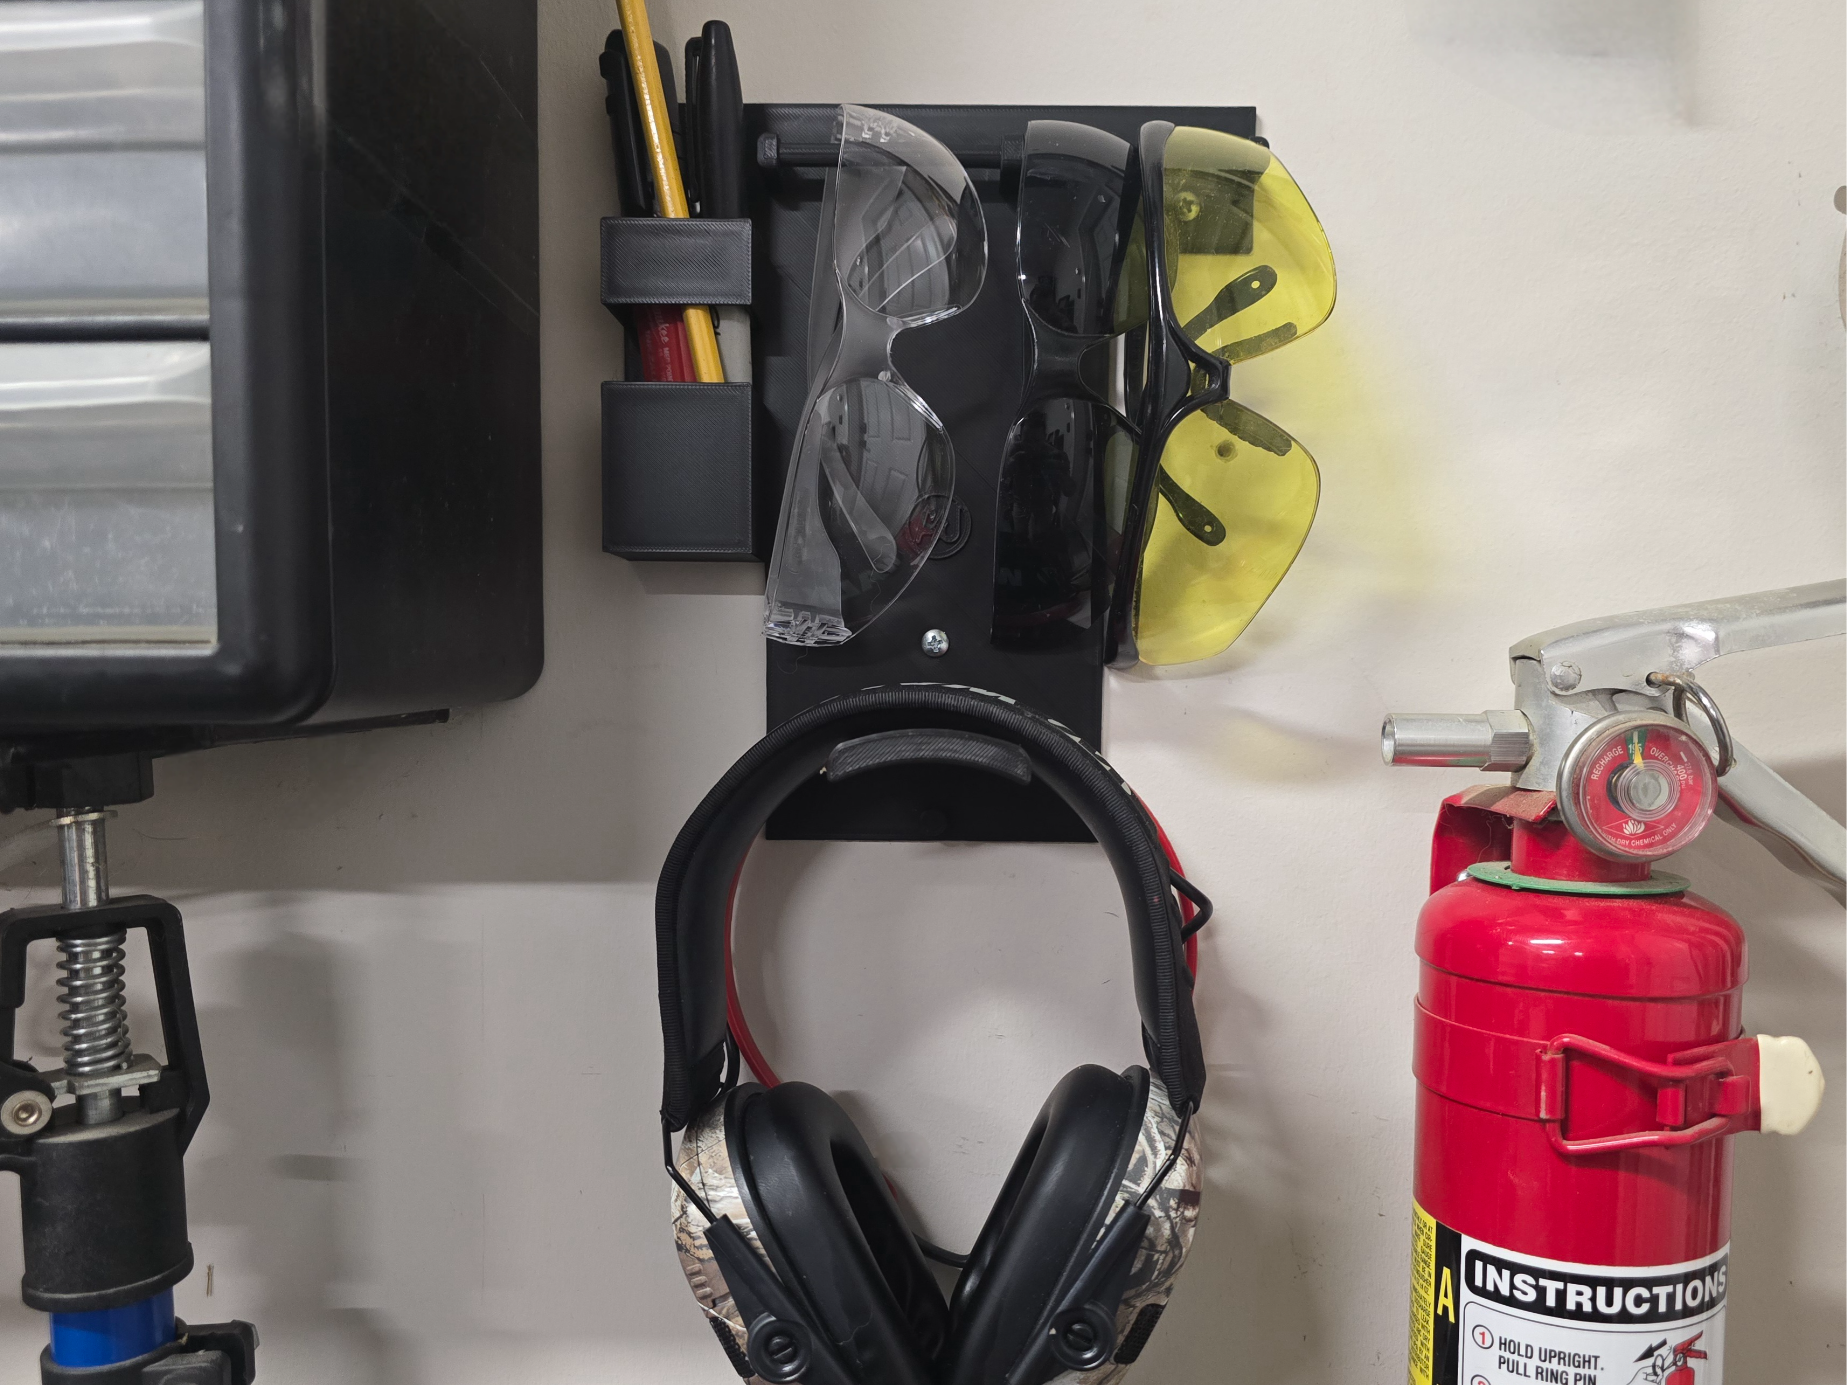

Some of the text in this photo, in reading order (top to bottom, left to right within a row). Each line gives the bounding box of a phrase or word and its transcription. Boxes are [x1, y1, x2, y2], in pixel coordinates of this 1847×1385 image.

[1591, 745, 1624, 780] RECHARGE
[1677, 764, 1687, 780] 400
[1617, 838, 1629, 846] DRY
[1631, 834, 1663, 846] CHEMICAL
[1663, 822, 1677, 836] ONLY
[1437, 1266, 1456, 1324] A
[1474, 1259, 1727, 1315] INSTRUCTIONS
[1478, 1331, 1486, 1345] 1
[1498, 1336, 1604, 1371] HOLD UPRIGHT.
[1498, 1355, 1597, 1385] PULL RING PIN
